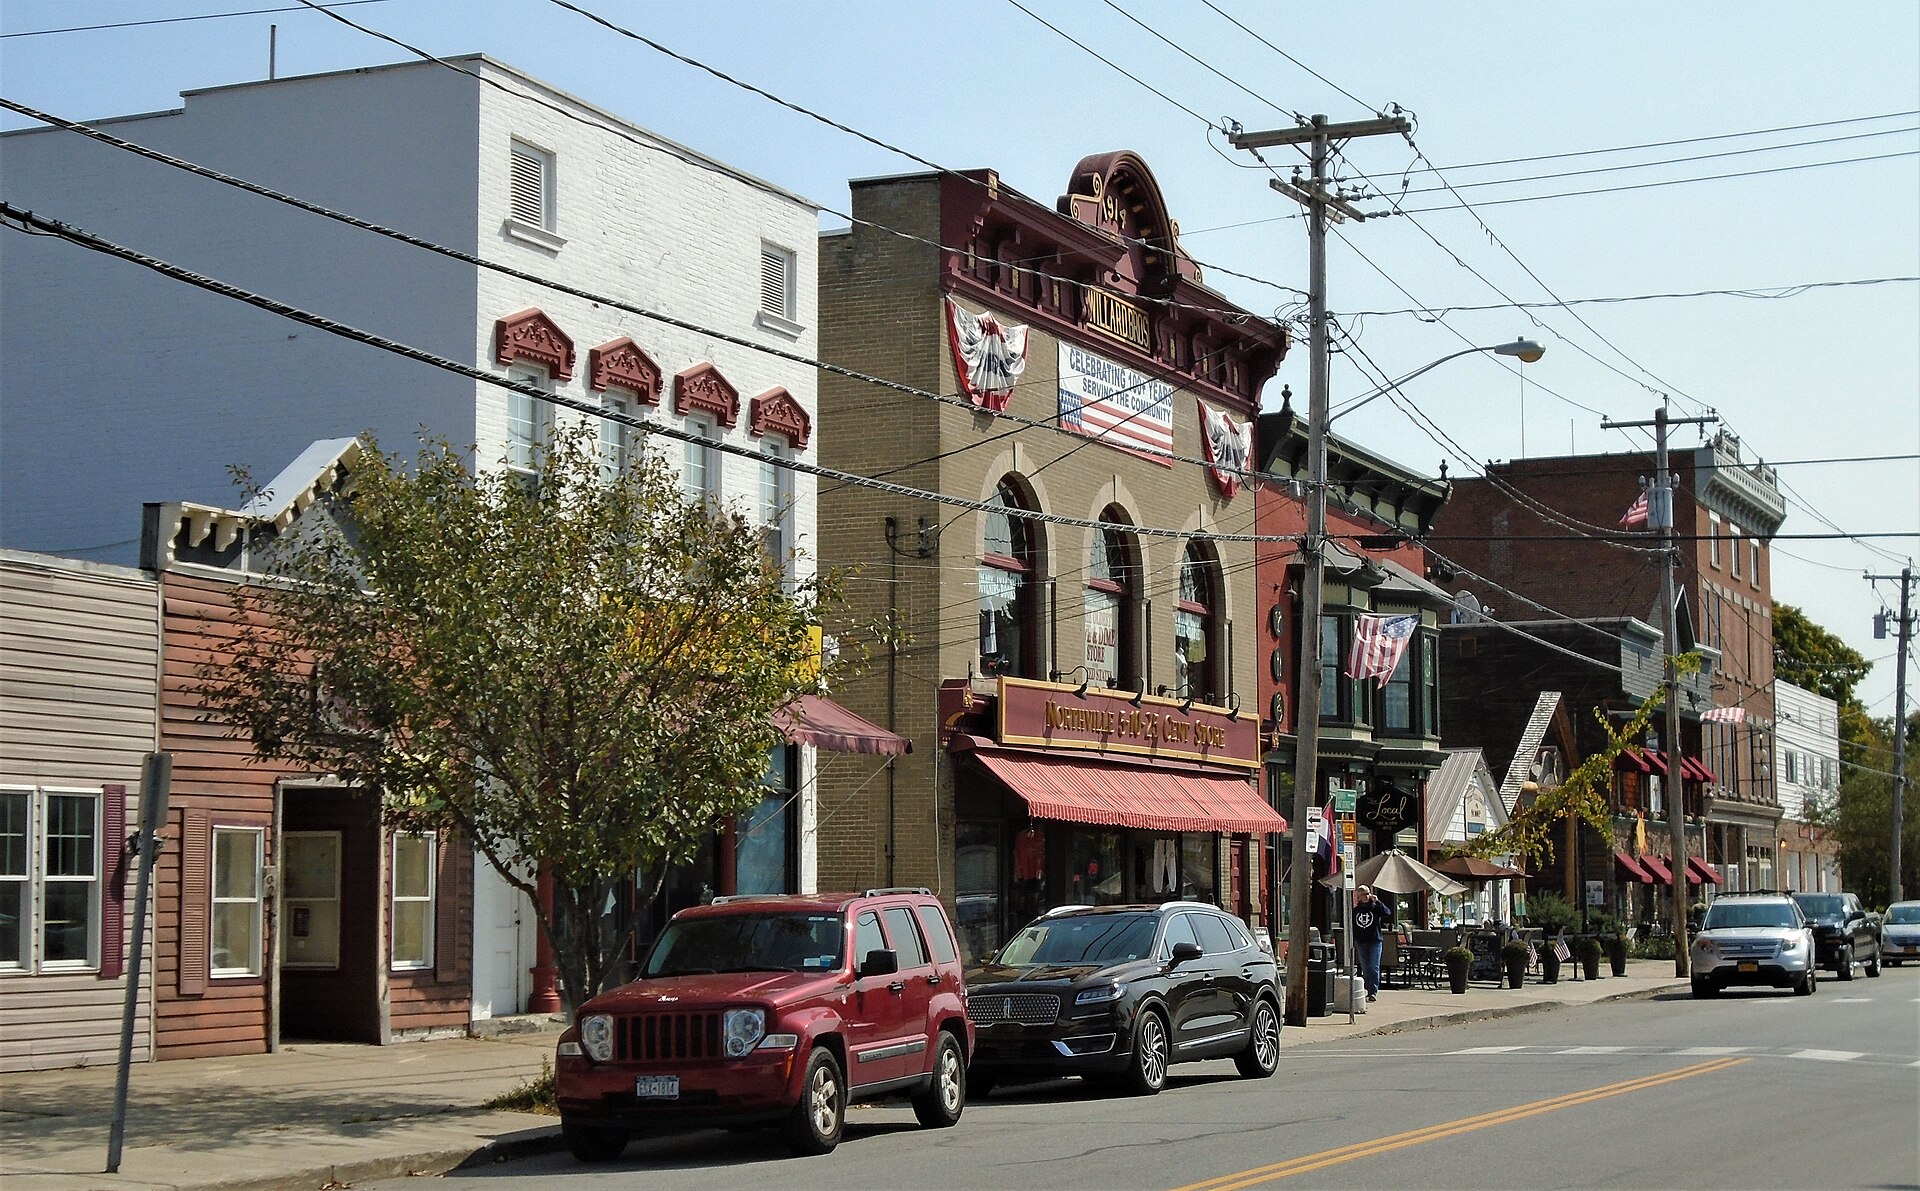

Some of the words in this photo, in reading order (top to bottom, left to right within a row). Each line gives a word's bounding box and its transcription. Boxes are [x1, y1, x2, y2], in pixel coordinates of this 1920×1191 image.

[1069, 348, 1126, 389] CELEBRATING
[1148, 381, 1173, 407] YEARS
[1082, 377, 1114, 402] SERVING
[1116, 390, 1130, 408] THE
[1130, 396, 1172, 423] COMMUNITY
[1098, 627, 1116, 648] DIME
[1086, 645, 1105, 663] STORE
[1366, 793, 1407, 820] Local
